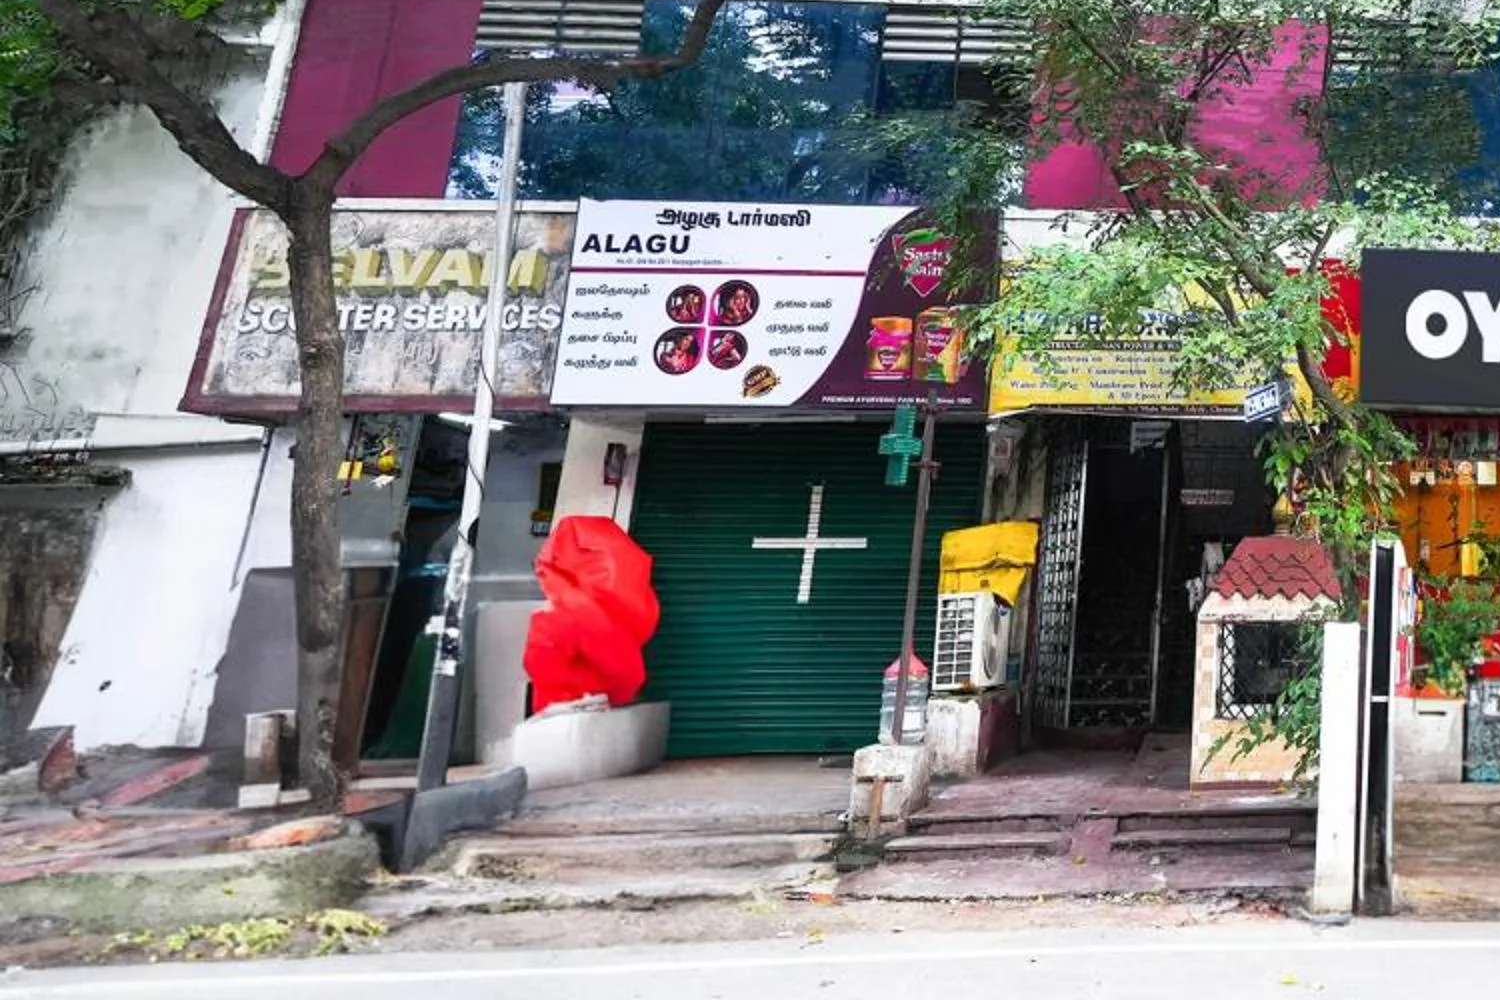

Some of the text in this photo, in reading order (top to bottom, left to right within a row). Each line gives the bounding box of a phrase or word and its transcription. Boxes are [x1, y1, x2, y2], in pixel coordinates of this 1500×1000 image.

[656, 209, 720, 230] அழகு
[581, 234, 690, 254] ALAGU
[239, 302, 561, 333] SCTER SERVCES
